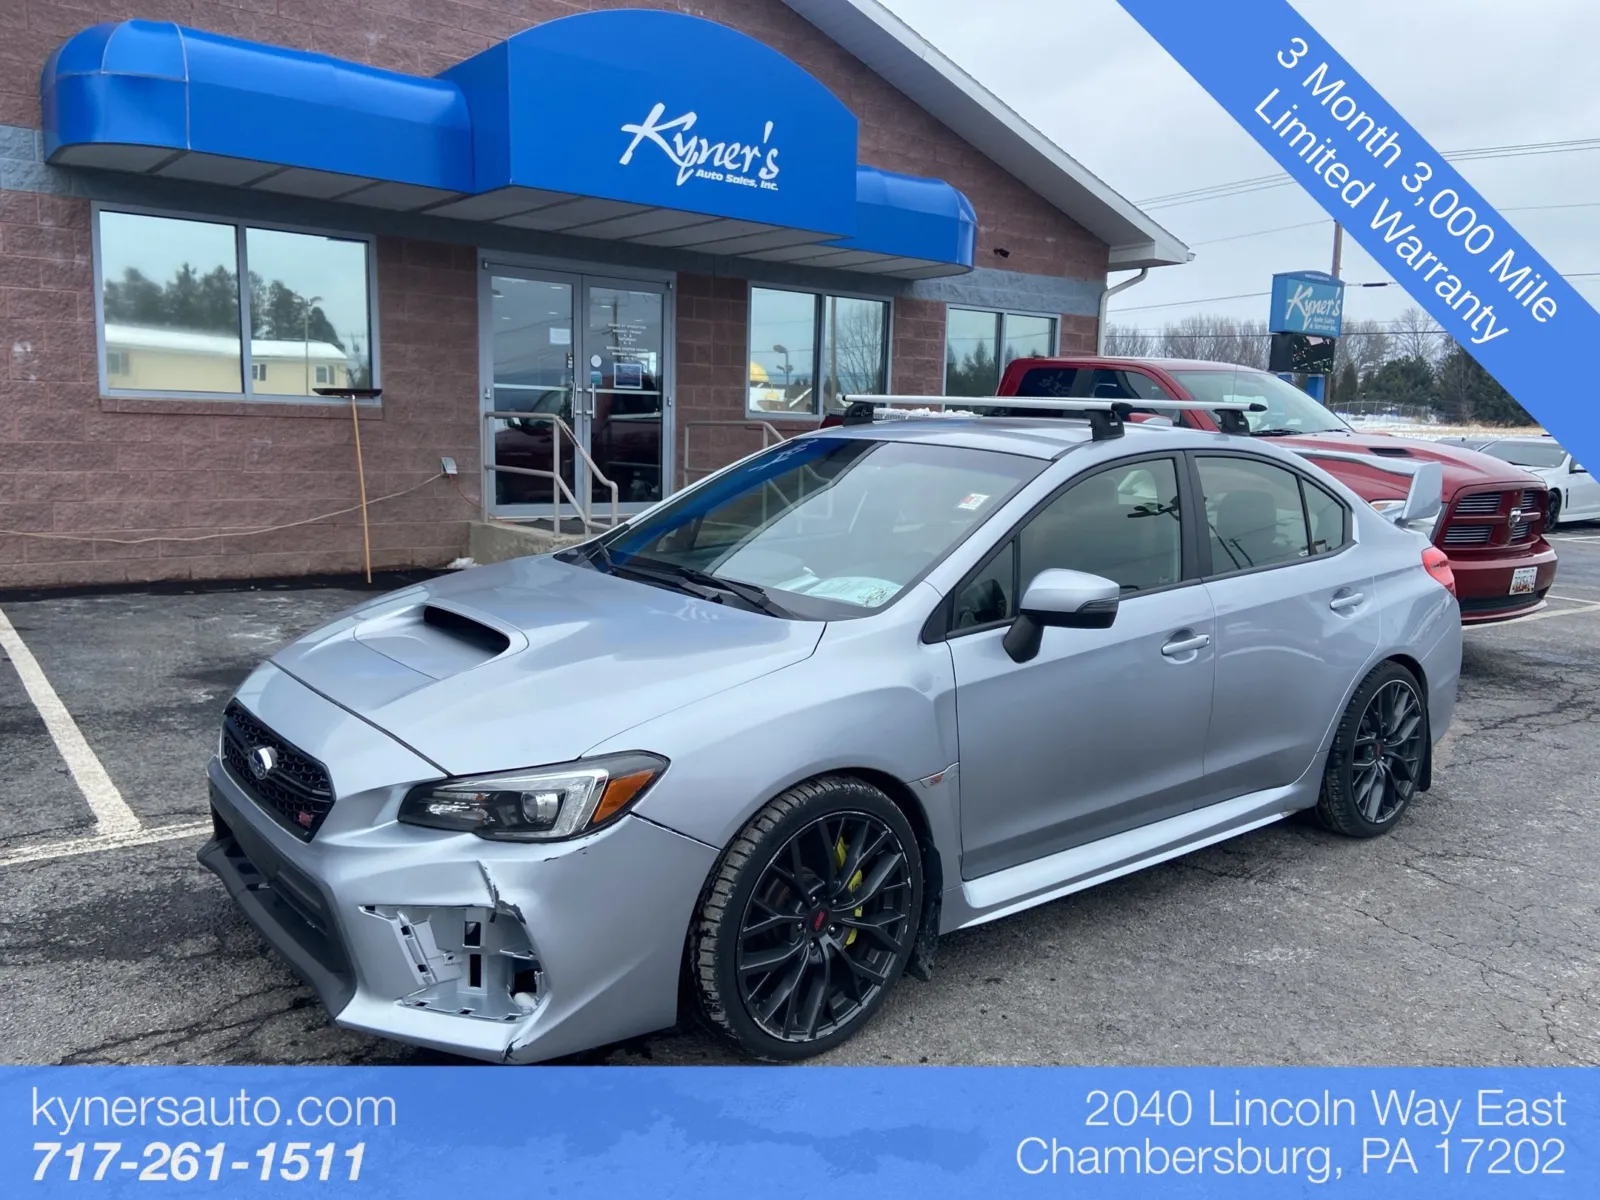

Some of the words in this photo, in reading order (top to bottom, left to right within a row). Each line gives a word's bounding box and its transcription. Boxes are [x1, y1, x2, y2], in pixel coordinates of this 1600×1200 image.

[619, 102, 779, 186] Kyner's
[695, 169, 723, 181] Auto
[725, 174, 758, 188] Sales,
[760, 180, 778, 190] Inc.
[1285, 284, 1340, 331] Kyner's
